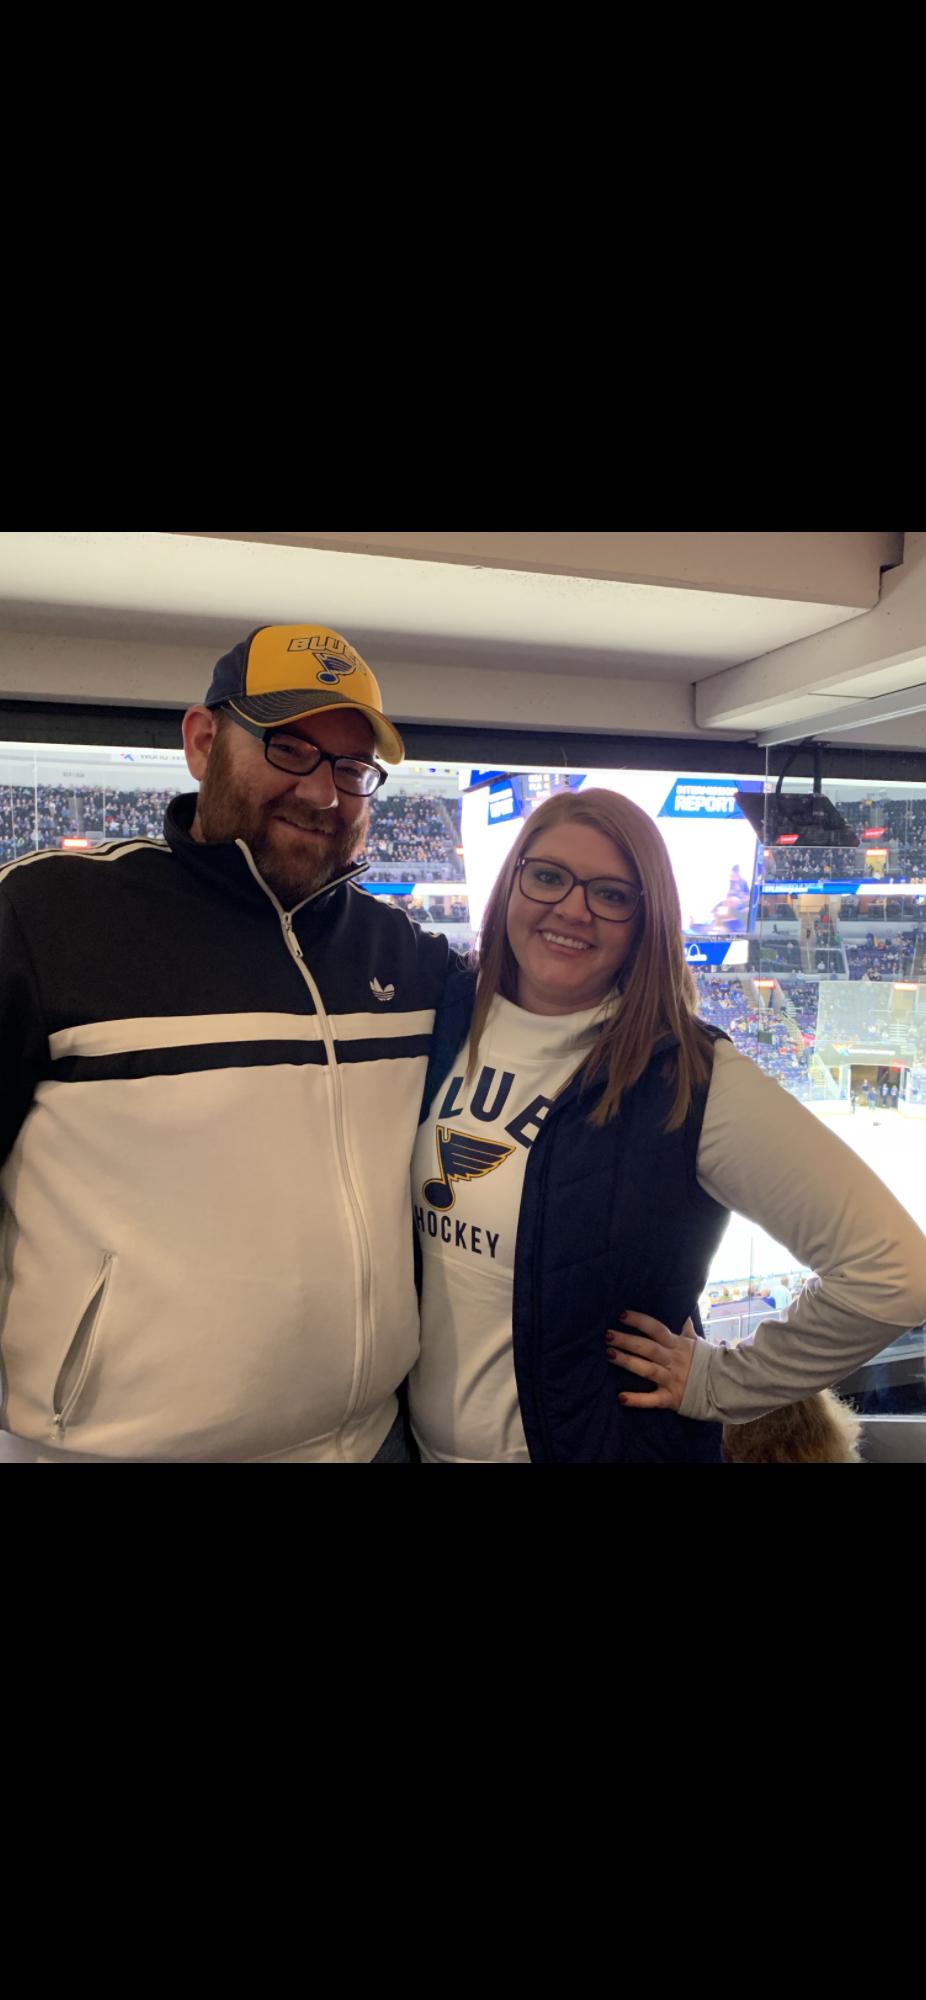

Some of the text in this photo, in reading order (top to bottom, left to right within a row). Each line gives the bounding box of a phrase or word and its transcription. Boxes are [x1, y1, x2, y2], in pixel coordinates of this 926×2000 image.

[287, 636, 355, 660] BLU
[674, 795, 736, 812] REPORT
[422, 1066, 553, 1149] LUE
[414, 1206, 499, 1258] HOCKEY
